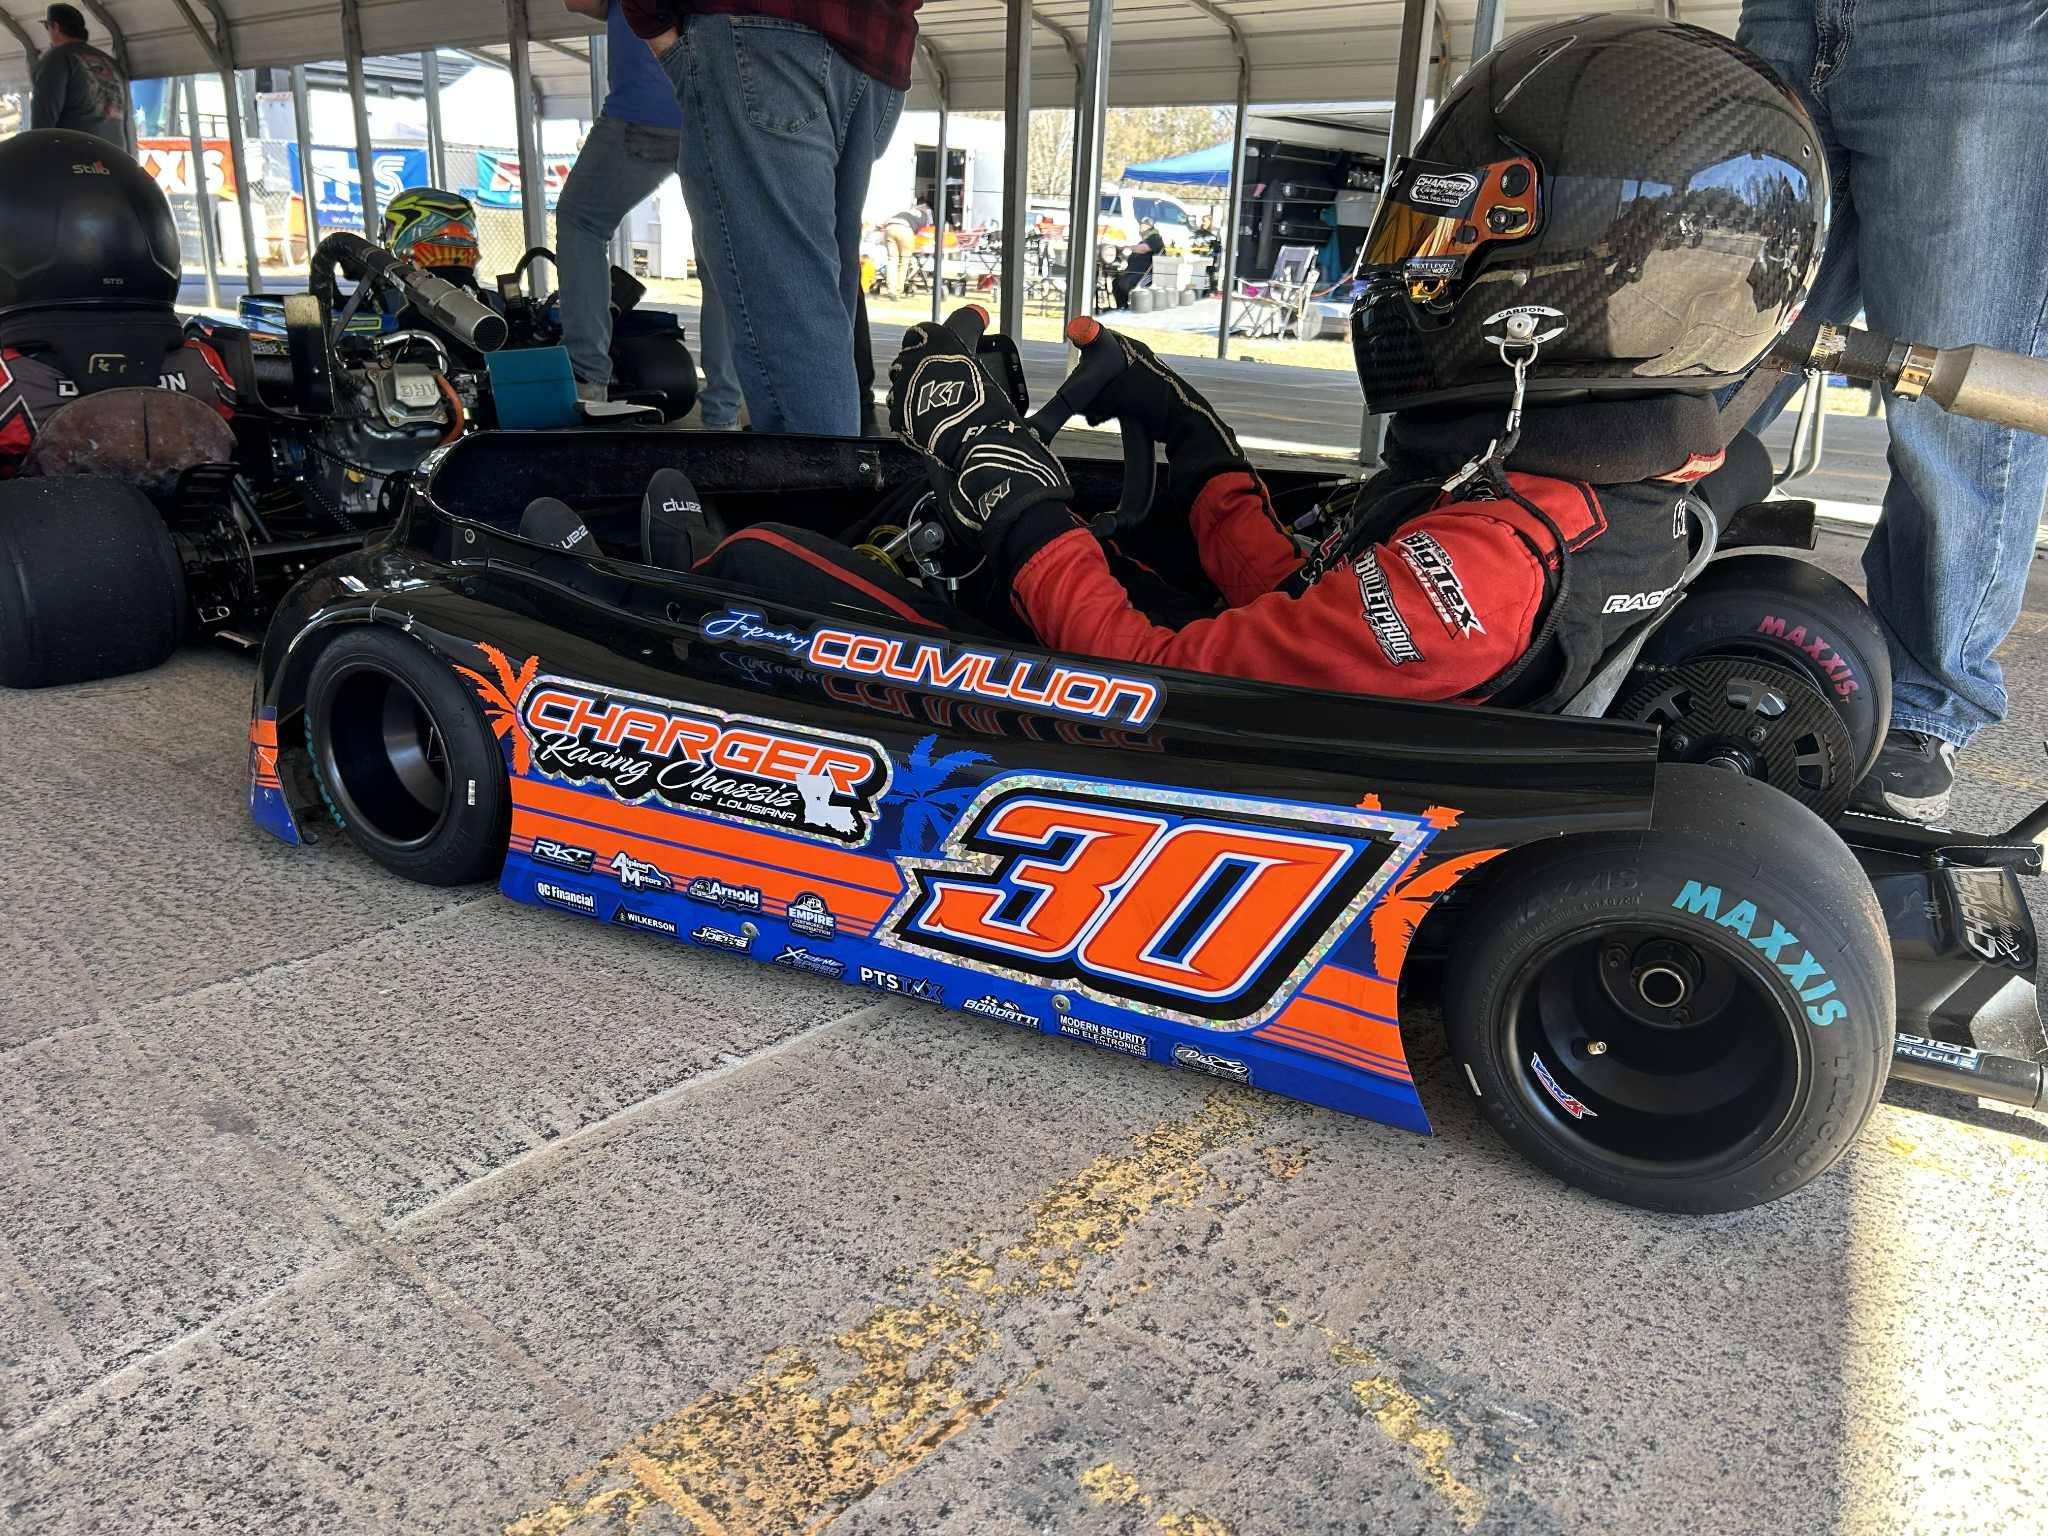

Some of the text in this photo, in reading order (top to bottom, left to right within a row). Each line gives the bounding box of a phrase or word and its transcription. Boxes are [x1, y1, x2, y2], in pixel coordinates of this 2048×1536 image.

[1417, 177, 1470, 191] CHARGER
[1498, 307, 1545, 318] CARBON
[917, 380, 965, 416] K1
[706, 609, 1158, 725] Jeremy COUVILLION
[1758, 615, 1859, 697] MAXXIS
[525, 690, 875, 797] CHARGER
[540, 732, 800, 807] Racing Chassis
[690, 791, 797, 822] OF LOUISIANA
[535, 839, 592, 862] RKT
[621, 867, 662, 887] Motors
[537, 882, 594, 908] QC Financial
[711, 882, 759, 905] Arnold
[918, 799, 1355, 998] 30
[628, 912, 675, 932] WILKERSON
[788, 907, 834, 927] EMPIRE
[1672, 880, 1849, 1026] MAXXIS
[1060, 1015, 1146, 1044] MODERN SECURITY
[1061, 1025, 1080, 1036] AND
[1082, 1030, 1146, 1053] ELECTRONICS
